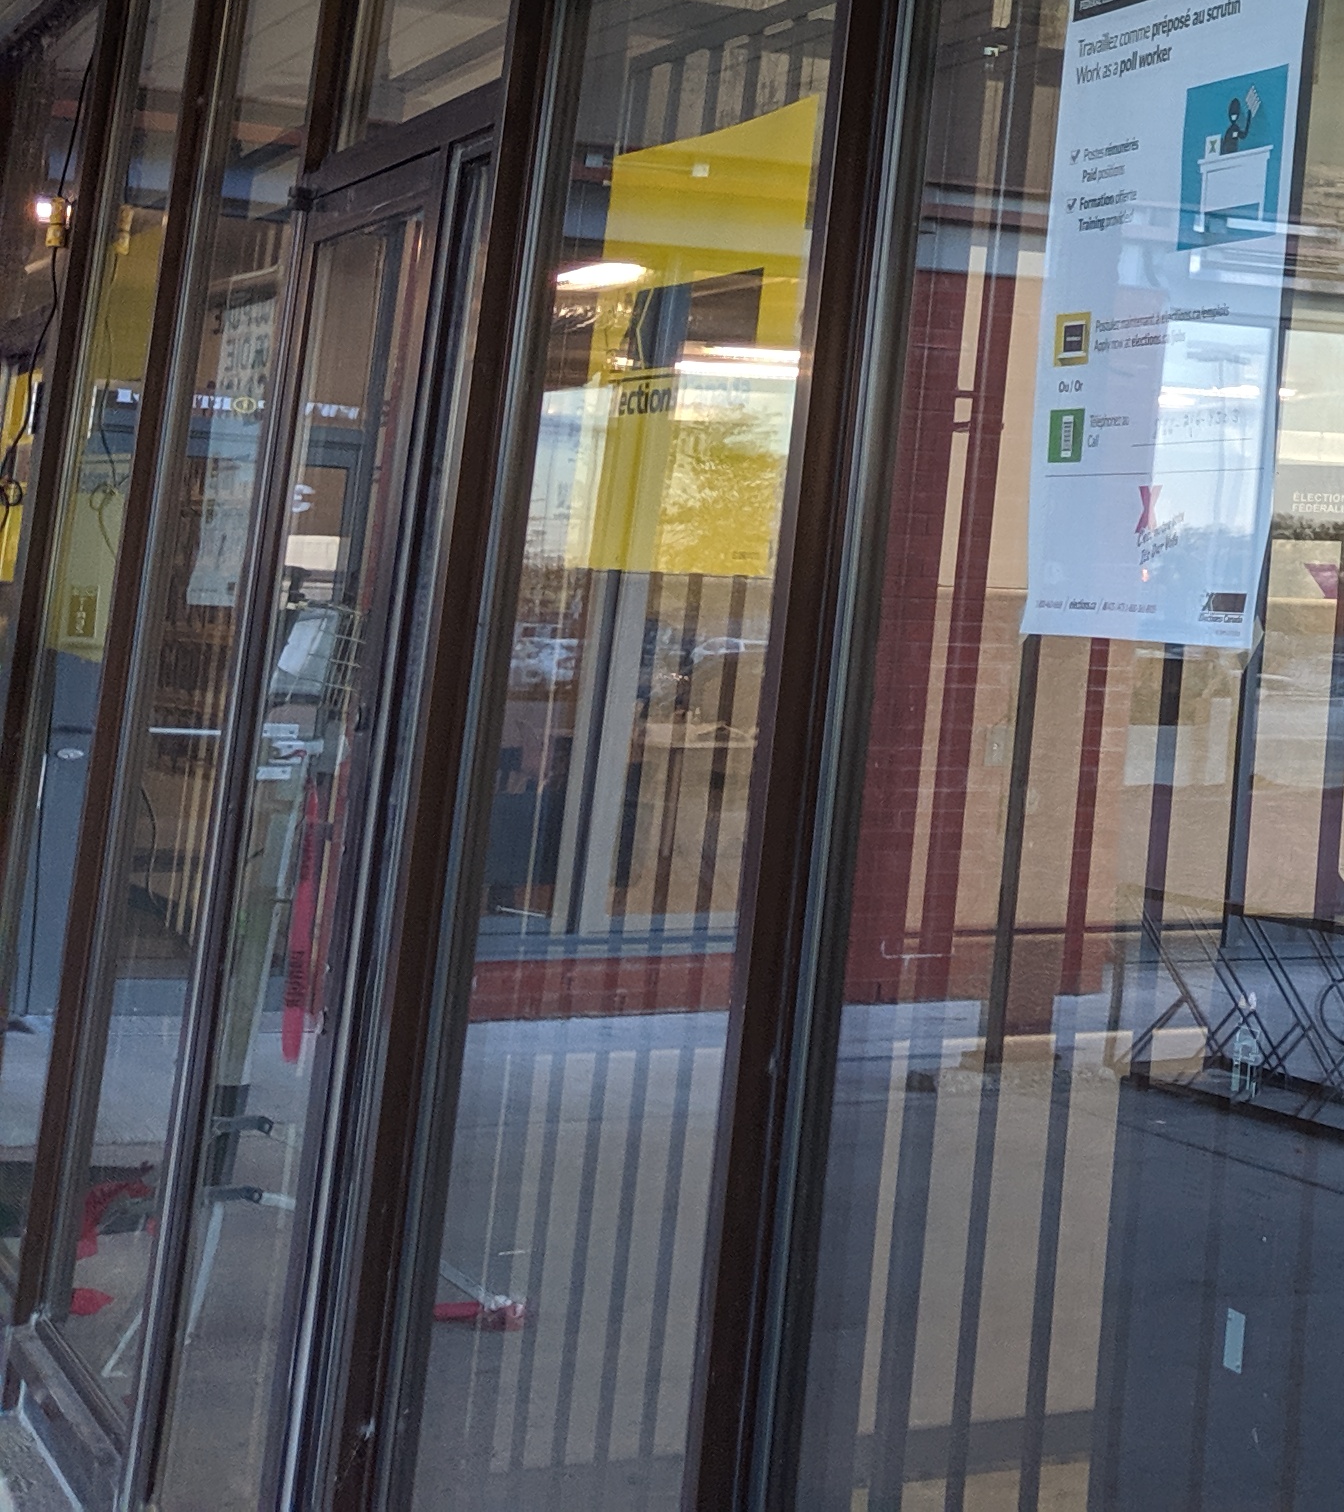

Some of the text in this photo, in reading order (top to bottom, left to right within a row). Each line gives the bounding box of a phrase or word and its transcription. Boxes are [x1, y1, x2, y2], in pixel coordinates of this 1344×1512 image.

[1118, 24, 1151, 47] comme
[1151, 8, 1191, 41] préposé
[1192, 10, 1205, 27] au
[1076, 44, 1173, 85] Work as a poll worker
[1087, 434, 1100, 448] Call
